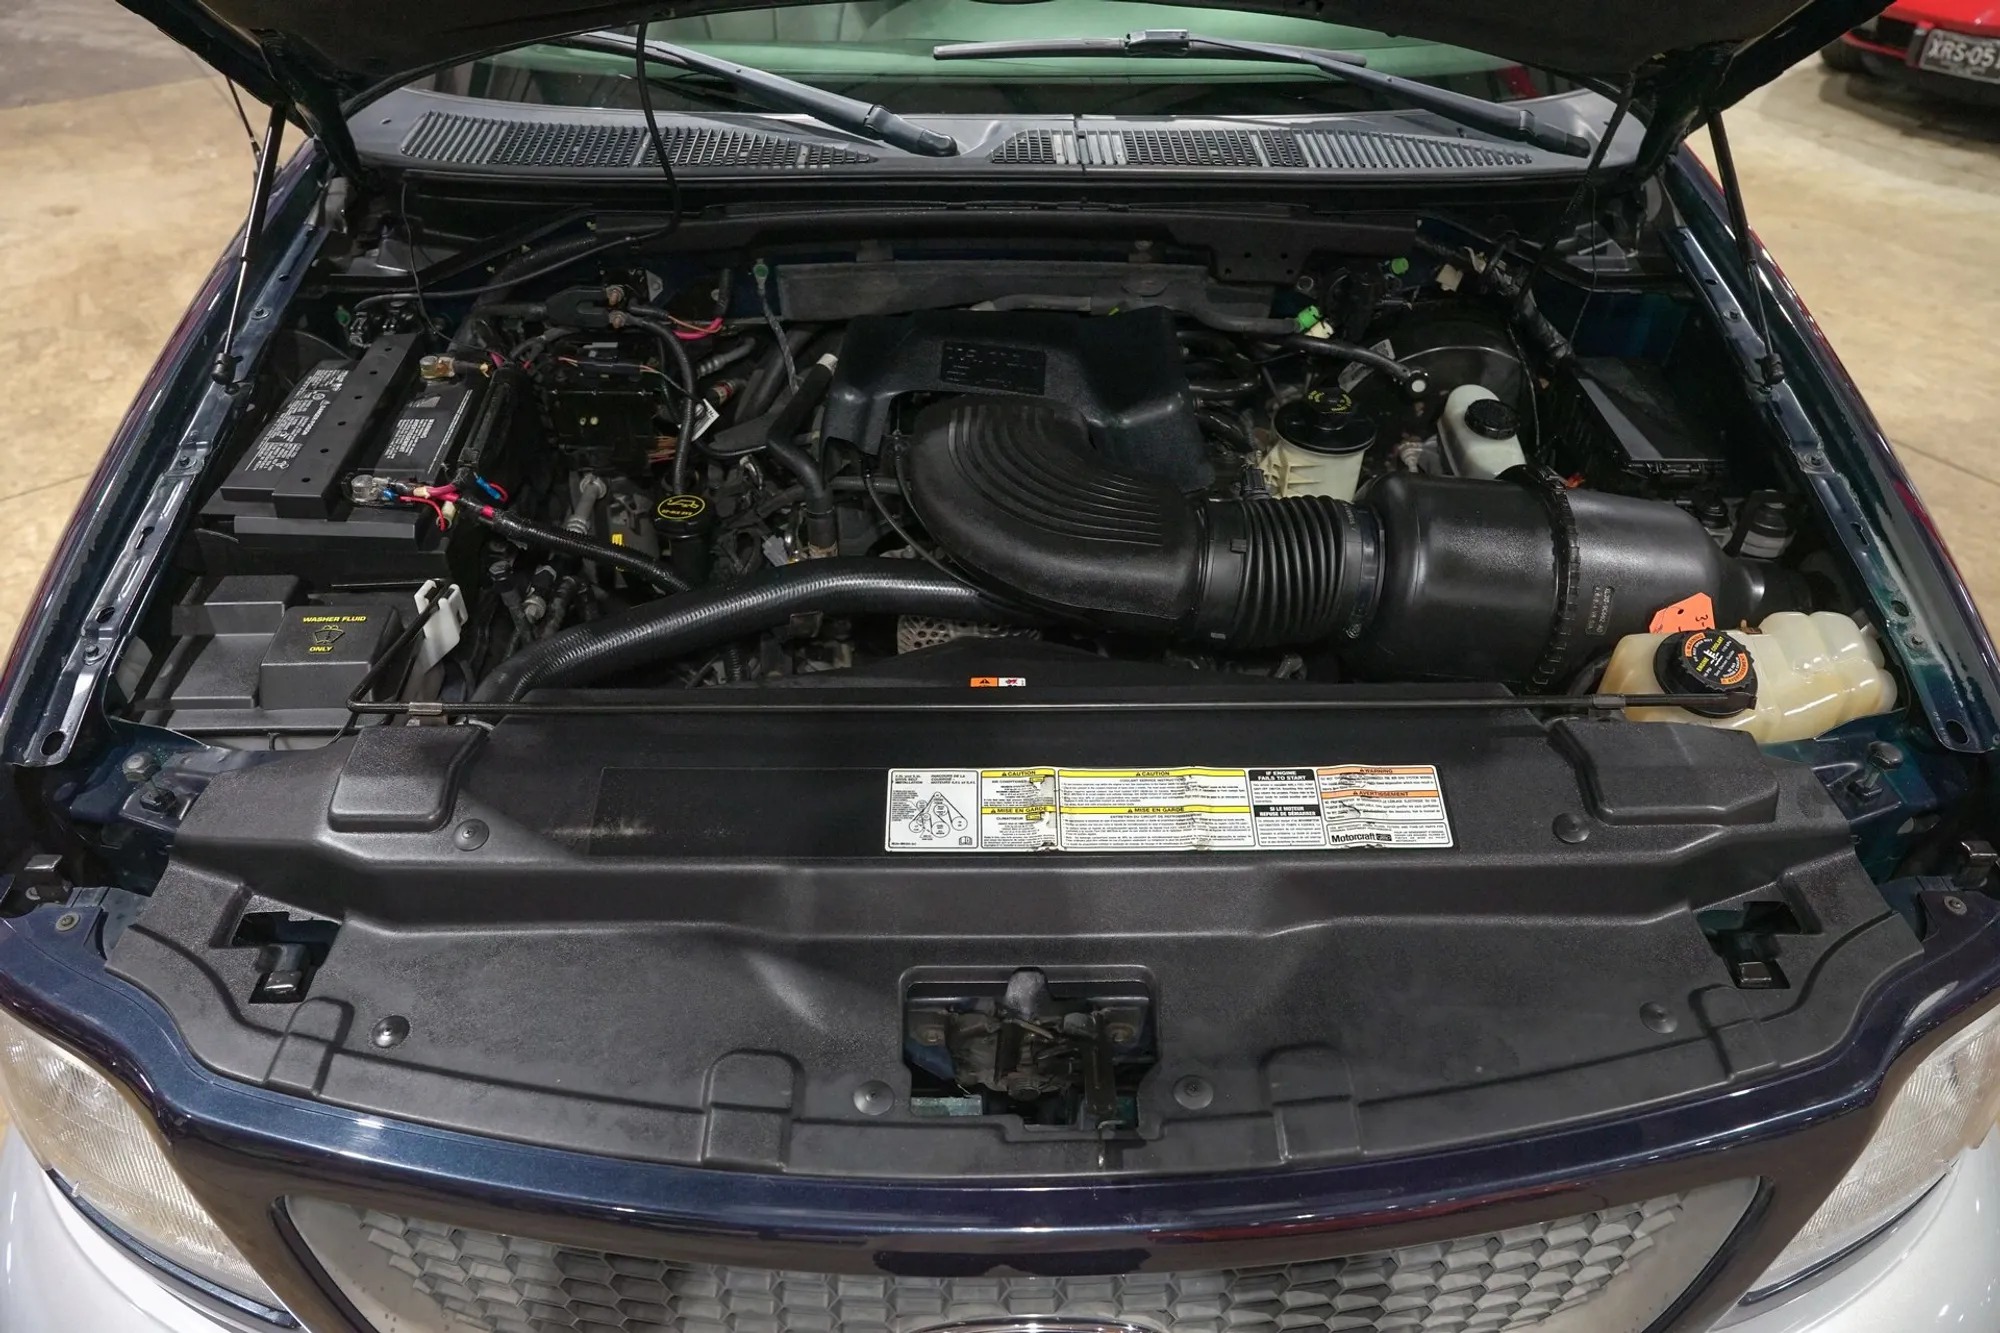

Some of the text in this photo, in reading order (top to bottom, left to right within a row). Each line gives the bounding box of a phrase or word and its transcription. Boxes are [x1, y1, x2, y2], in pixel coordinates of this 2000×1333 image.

[1710, 636, 1724, 652] COOLANT
[1696, 657, 1710, 672] ENGINE
[1331, 833, 1376, 843] Motorcraft
